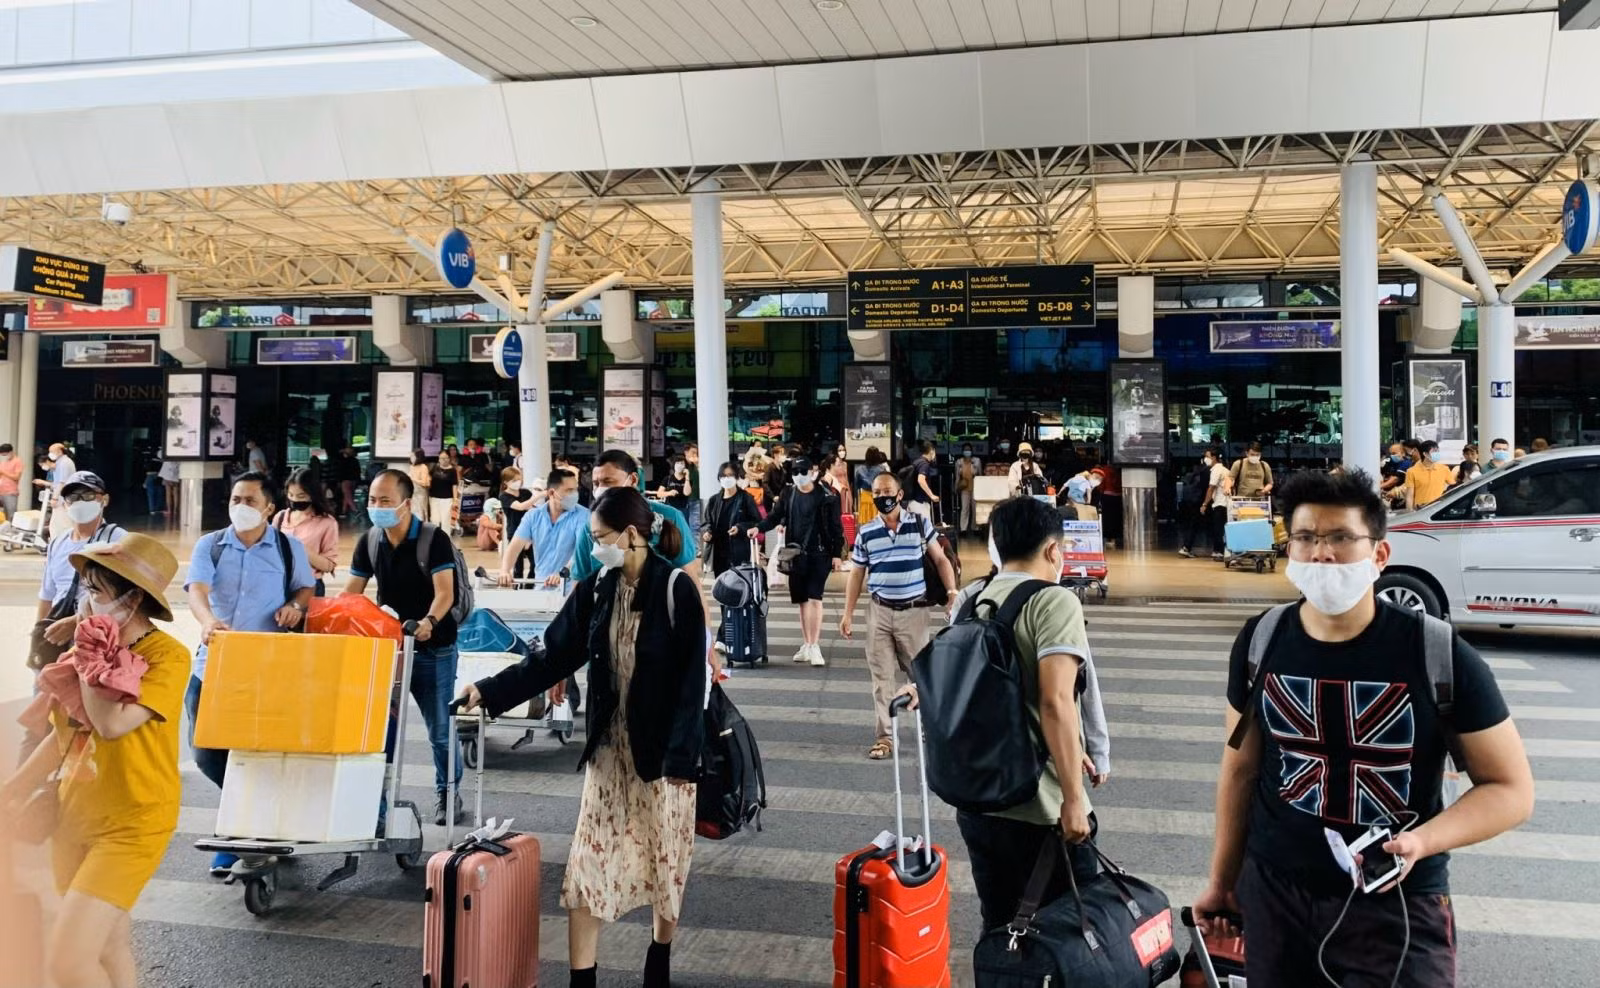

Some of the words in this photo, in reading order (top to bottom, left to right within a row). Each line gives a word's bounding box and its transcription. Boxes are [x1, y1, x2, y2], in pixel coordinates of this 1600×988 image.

[448, 251, 470, 268] VIB
[931, 280, 964, 290] A1-A3
[931, 304, 964, 313] D1-D4
[1038, 302, 1073, 312] D5-D8
[1475, 596, 1559, 607] INNOVA
